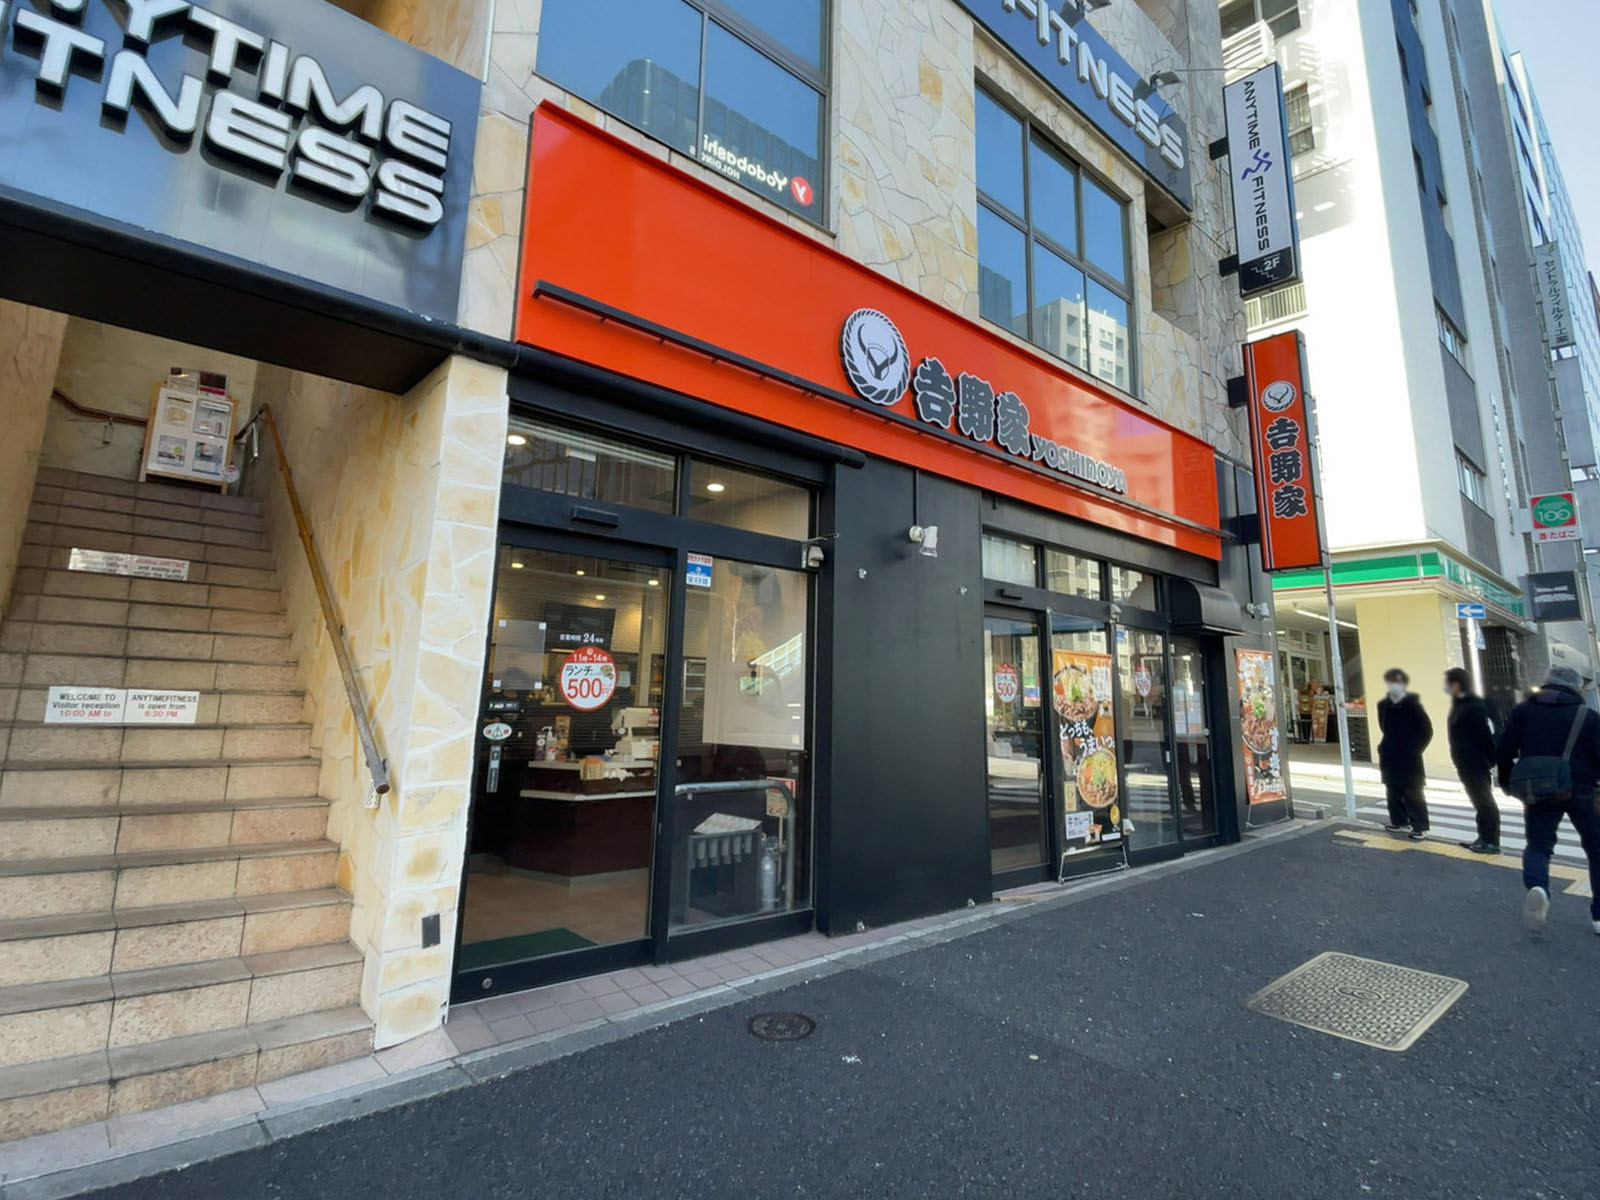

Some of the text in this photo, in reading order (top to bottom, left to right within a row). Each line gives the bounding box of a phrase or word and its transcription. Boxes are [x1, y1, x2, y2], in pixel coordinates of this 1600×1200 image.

[0, 0, 444, 225] TNESS
[52, 0, 453, 171] YTIME
[1243, 80, 1270, 251] ANYTIME FITNESS
[1263, 257, 1281, 271] 2F
[1032, 434, 1127, 494] YOSHINOYA
[81, 702, 120, 710] reception
